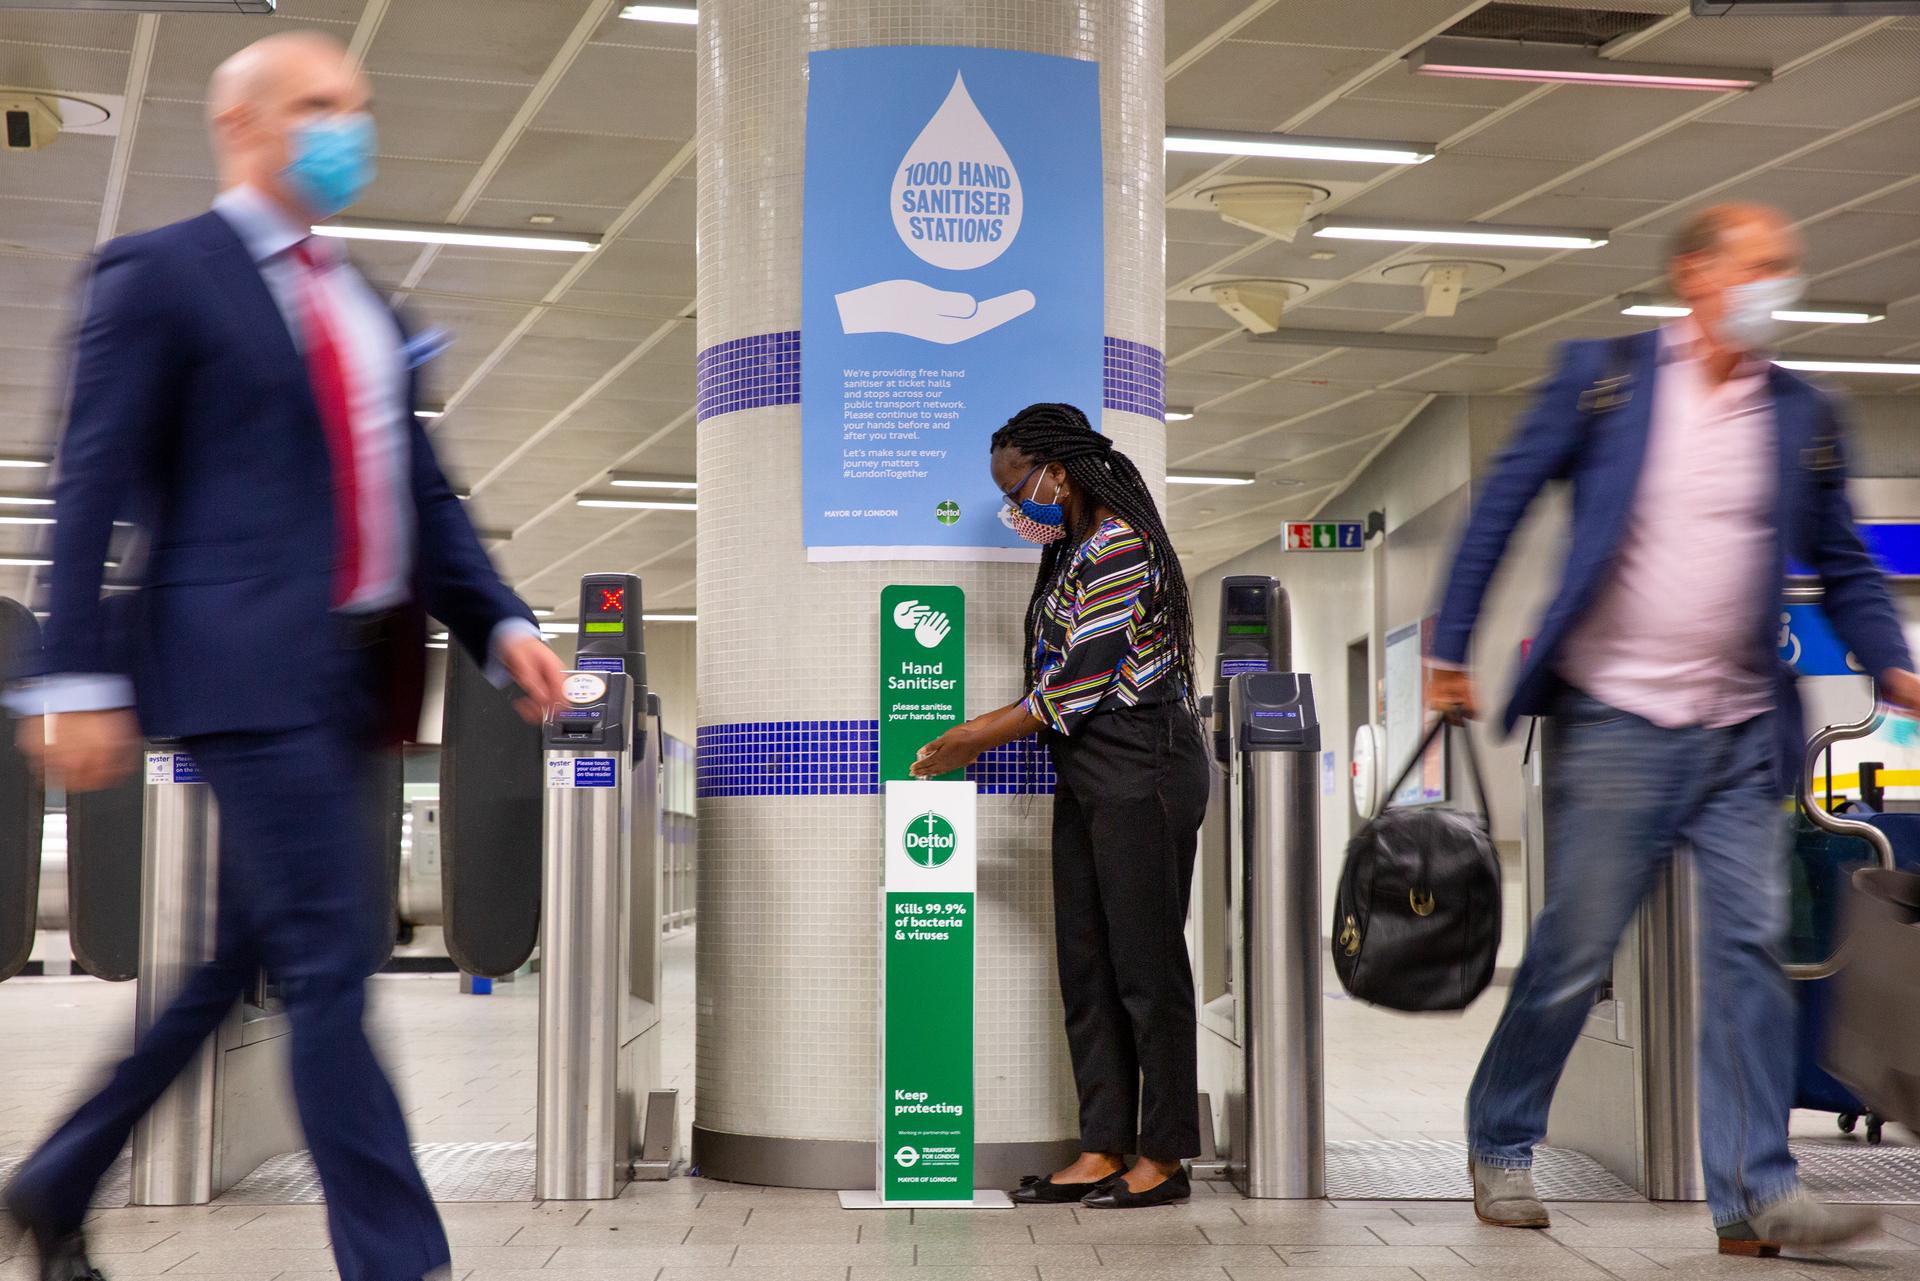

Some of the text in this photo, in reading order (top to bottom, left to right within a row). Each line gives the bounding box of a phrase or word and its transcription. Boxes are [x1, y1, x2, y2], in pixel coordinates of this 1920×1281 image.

[905, 161, 1011, 189] 1000 HAND
[902, 189, 1011, 216] SANITISER
[909, 216, 1003, 242] STATIONS
[843, 368, 965, 379] We're providing free hand
[843, 379, 952, 388] sanitiser at ticket halls
[843, 390, 862, 399] and
[863, 390, 890, 399] stops
[844, 400, 967, 410] public transport network.
[844, 410, 960, 419] Please continue to wash
[843, 421, 951, 431] your hands before and
[843, 432, 920, 441] after you travel.
[843, 449, 866, 458] Let's
[868, 449, 894, 457] make
[919, 450, 947, 459] every
[842, 460, 920, 470] journey matters
[843, 469, 929, 480] #LondonTogether
[824, 510, 850, 518] MAYOR
[864, 509, 898, 517] LONDON
[936, 508, 961, 517] Dettol
[902, 662, 943, 675] Hand
[888, 676, 957, 690] Sanitiser
[892, 702, 952, 712] please sanitise
[888, 712, 956, 722] your hands here
[549, 760, 571, 768] oyster
[906, 832, 954, 848] Dettol
[895, 903, 967, 915] Kills 99.9%
[894, 916, 963, 928] of bacteria
[894, 929, 949, 941] & viruses
[895, 1089, 928, 1103] Keep
[895, 1102, 963, 1116] protecting
